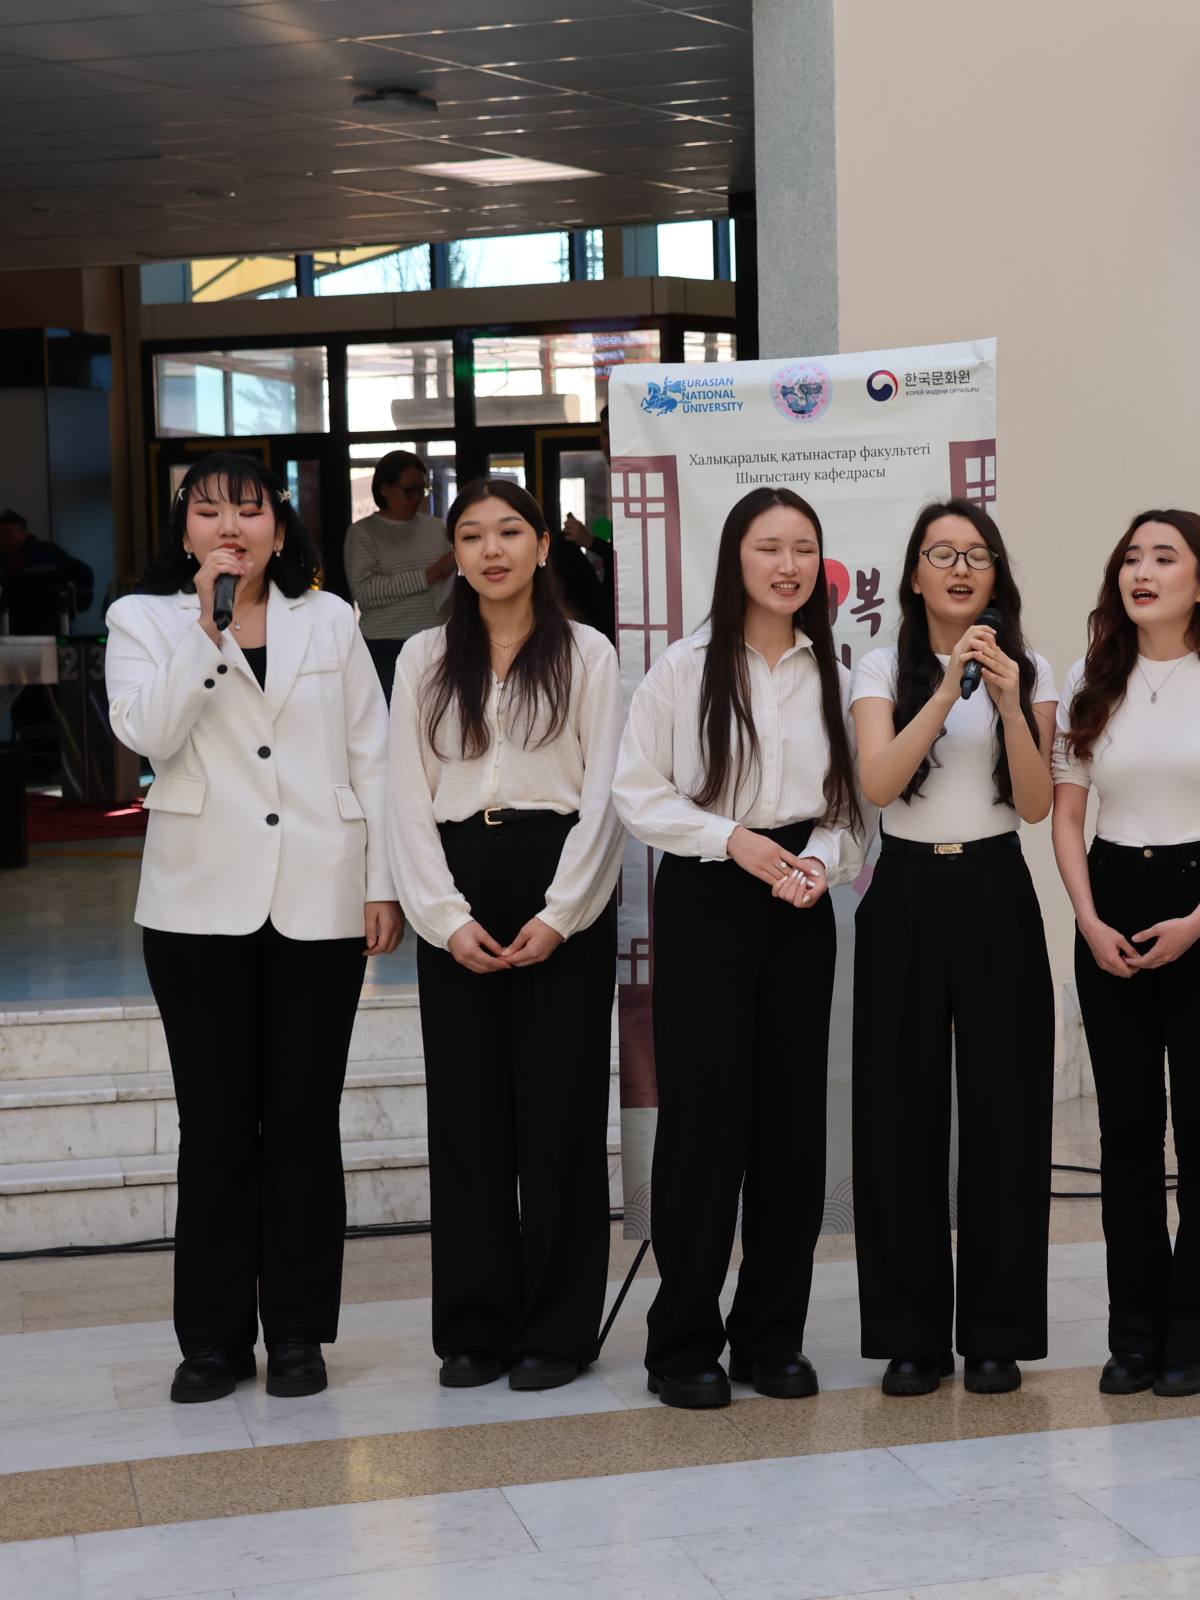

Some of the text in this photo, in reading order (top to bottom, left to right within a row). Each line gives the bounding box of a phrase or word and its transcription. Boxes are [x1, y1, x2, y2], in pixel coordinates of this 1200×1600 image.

[681, 377, 734, 388] EURASIAN
[904, 369, 971, 387] 한국문화원
[681, 389, 736, 400] NATIONAL
[683, 401, 744, 414] UNIVERSITY
[689, 443, 930, 468] Халықаралық қатынастар факультеті
[736, 467, 886, 485] Шығыстану кафедрасы
[59, 646, 78, 680] 2
